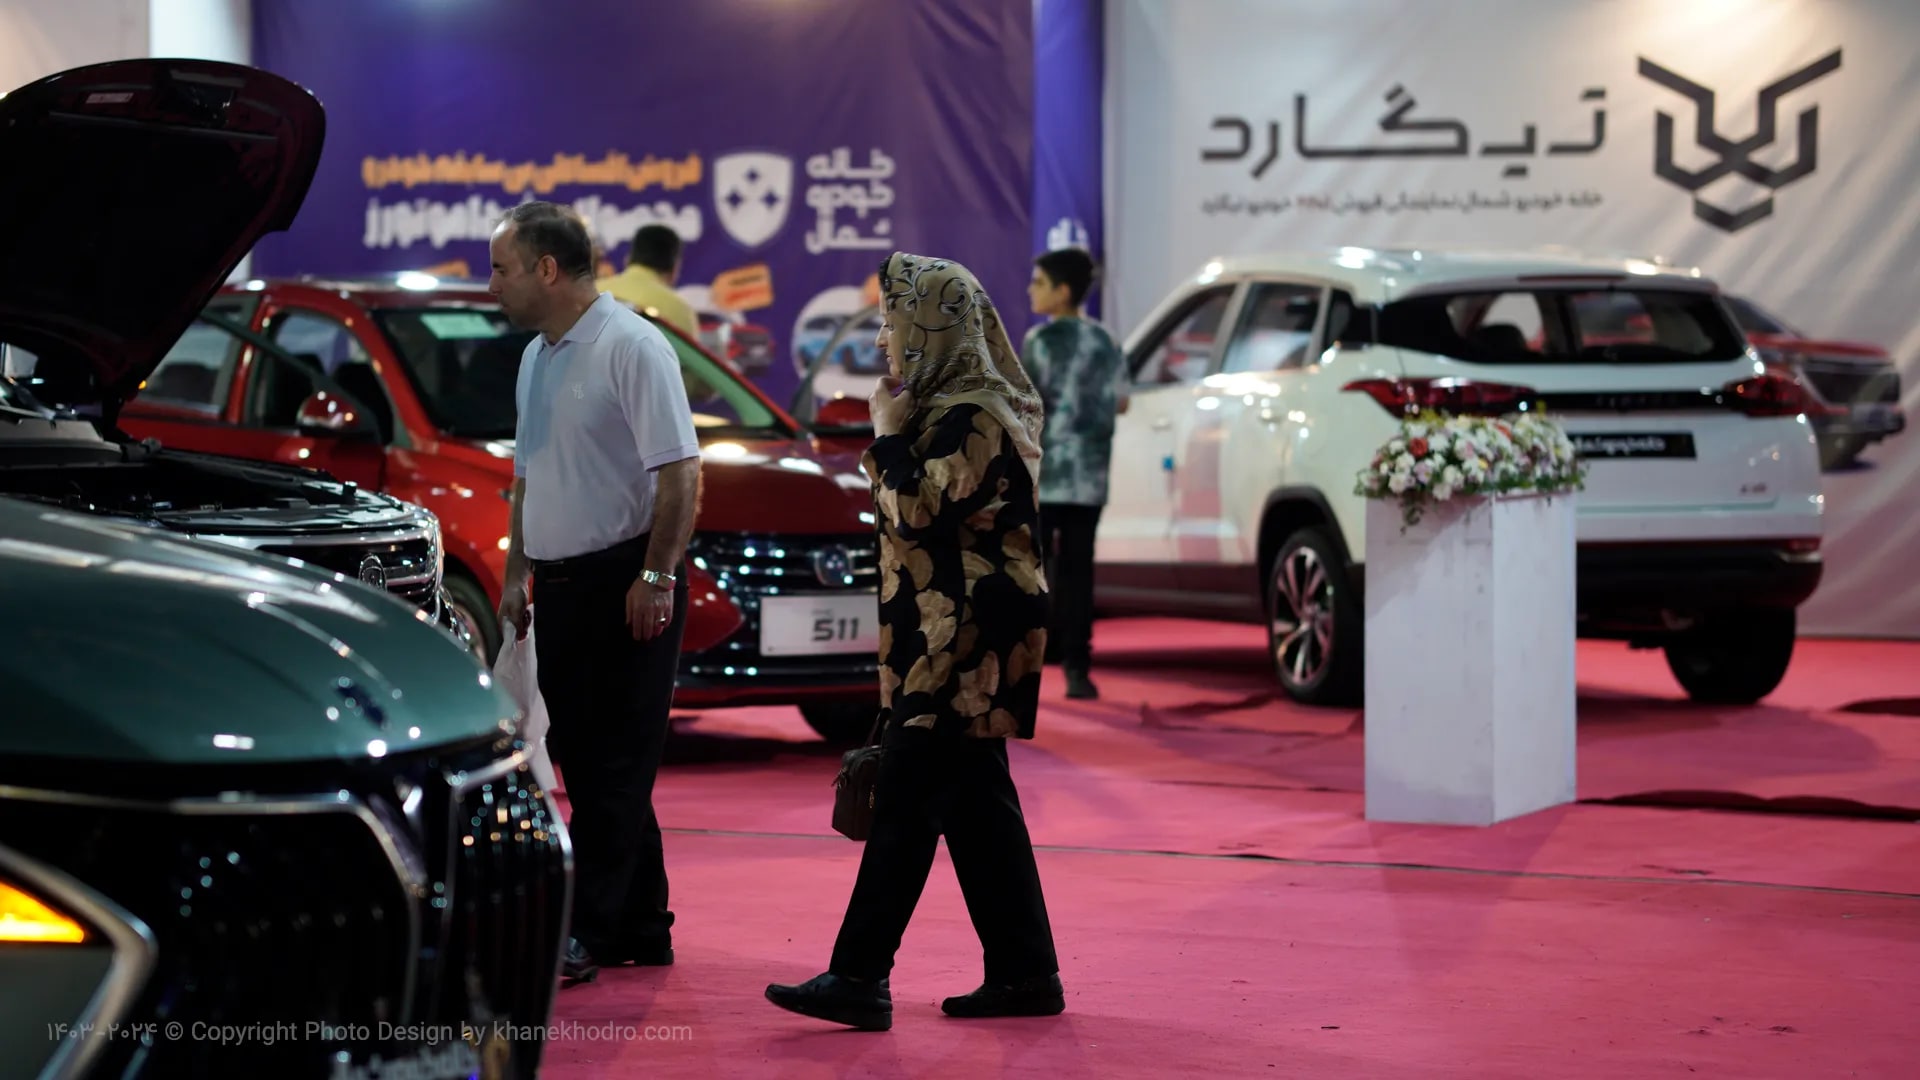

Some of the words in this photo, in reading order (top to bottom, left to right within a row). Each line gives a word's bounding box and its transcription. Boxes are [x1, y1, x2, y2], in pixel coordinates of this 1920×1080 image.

[1202, 85, 1606, 179] تیگارد
[805, 145, 895, 179] خانه
[805, 179, 895, 218] خودرو
[805, 217, 894, 254] شمال
[813, 616, 859, 641] 511
